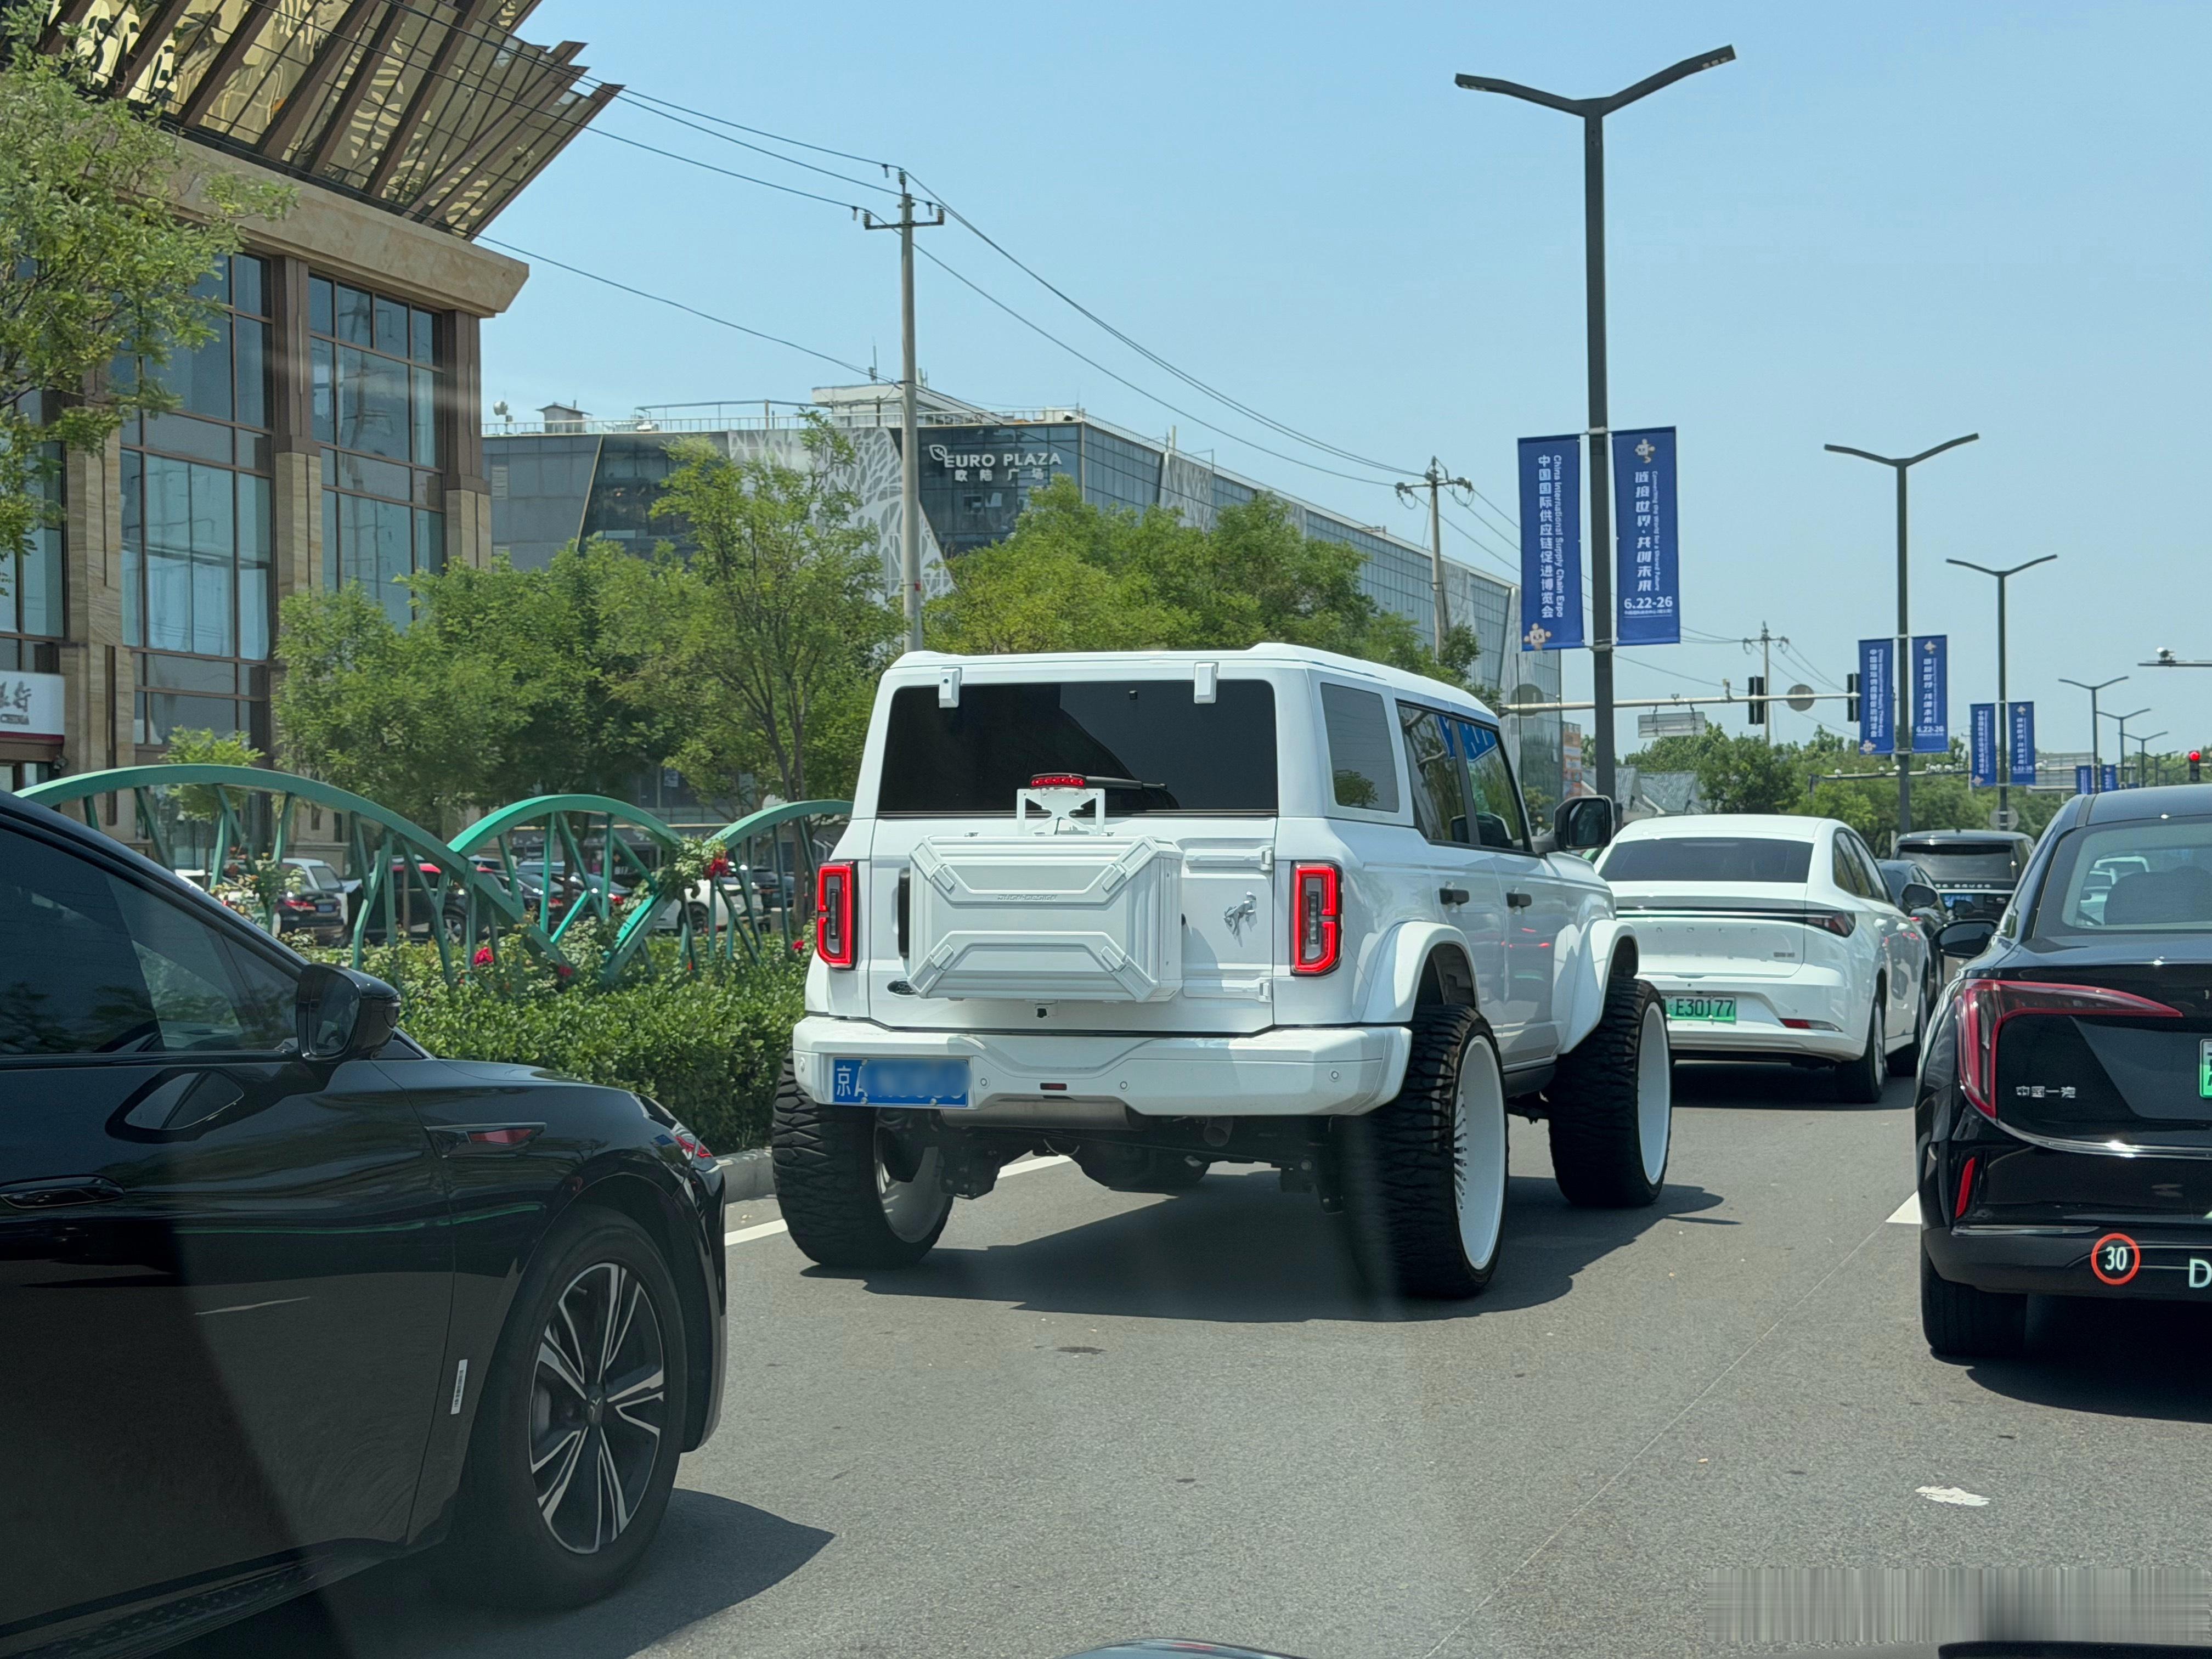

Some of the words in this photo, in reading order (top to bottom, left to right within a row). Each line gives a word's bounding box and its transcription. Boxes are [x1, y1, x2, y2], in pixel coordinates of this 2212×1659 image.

[944, 454, 995, 467] EURO
[1003, 453, 1062, 466] PLAZA
[1554, 455, 1562, 480] China
[955, 467, 1043, 482] 欧陆广场
[1554, 482, 1563, 535] International
[1538, 454, 1554, 618] 中国国际供应链促进博览会
[1554, 538, 1564, 567] Supply
[1556, 569, 1565, 594] Chain
[1555, 595, 1565, 618] Expo
[1624, 596, 1673, 610] 6.22-26
[1663, 998, 1734, 1017] E30177
[2016, 1086, 2075, 1098] 中国一汽
[2105, 1246, 2127, 1271] 30
